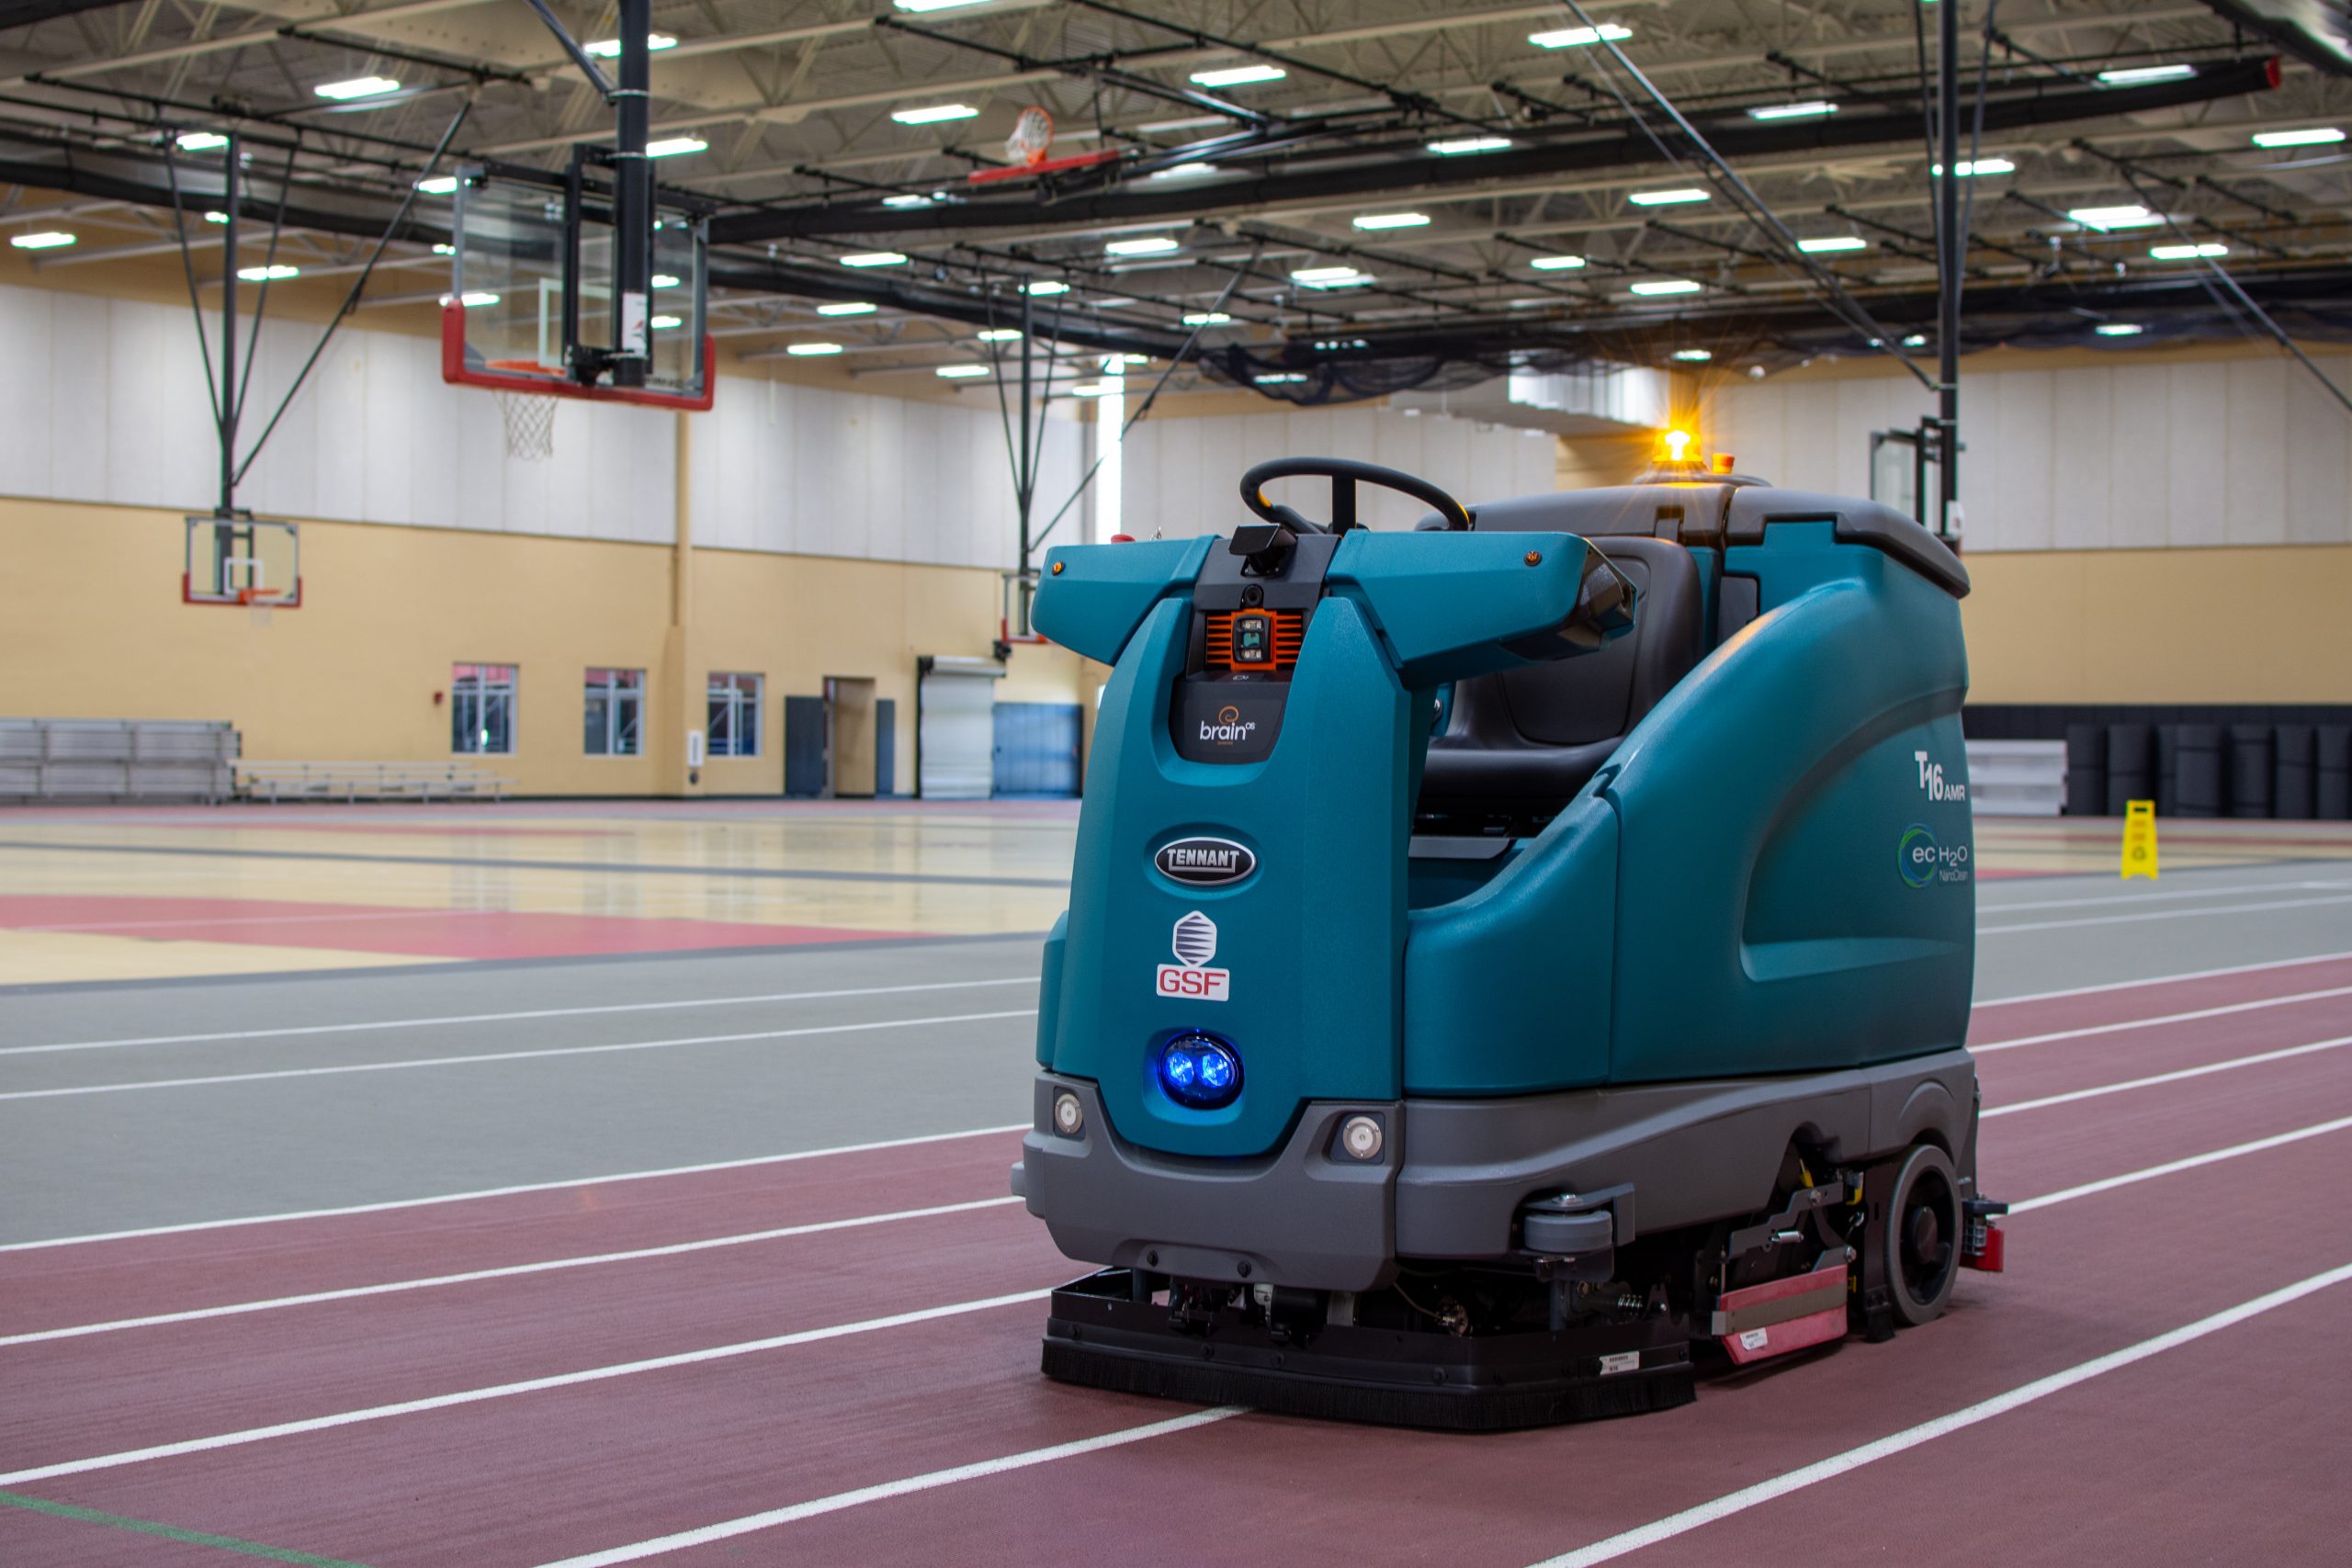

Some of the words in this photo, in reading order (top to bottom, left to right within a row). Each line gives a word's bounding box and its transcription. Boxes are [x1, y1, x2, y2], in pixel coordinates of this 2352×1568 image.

[1915, 750, 1943, 801] T16
[1944, 784, 1965, 801] AMR
[1167, 849, 1239, 873] TENNANT
[1159, 969, 1227, 996] GSF
